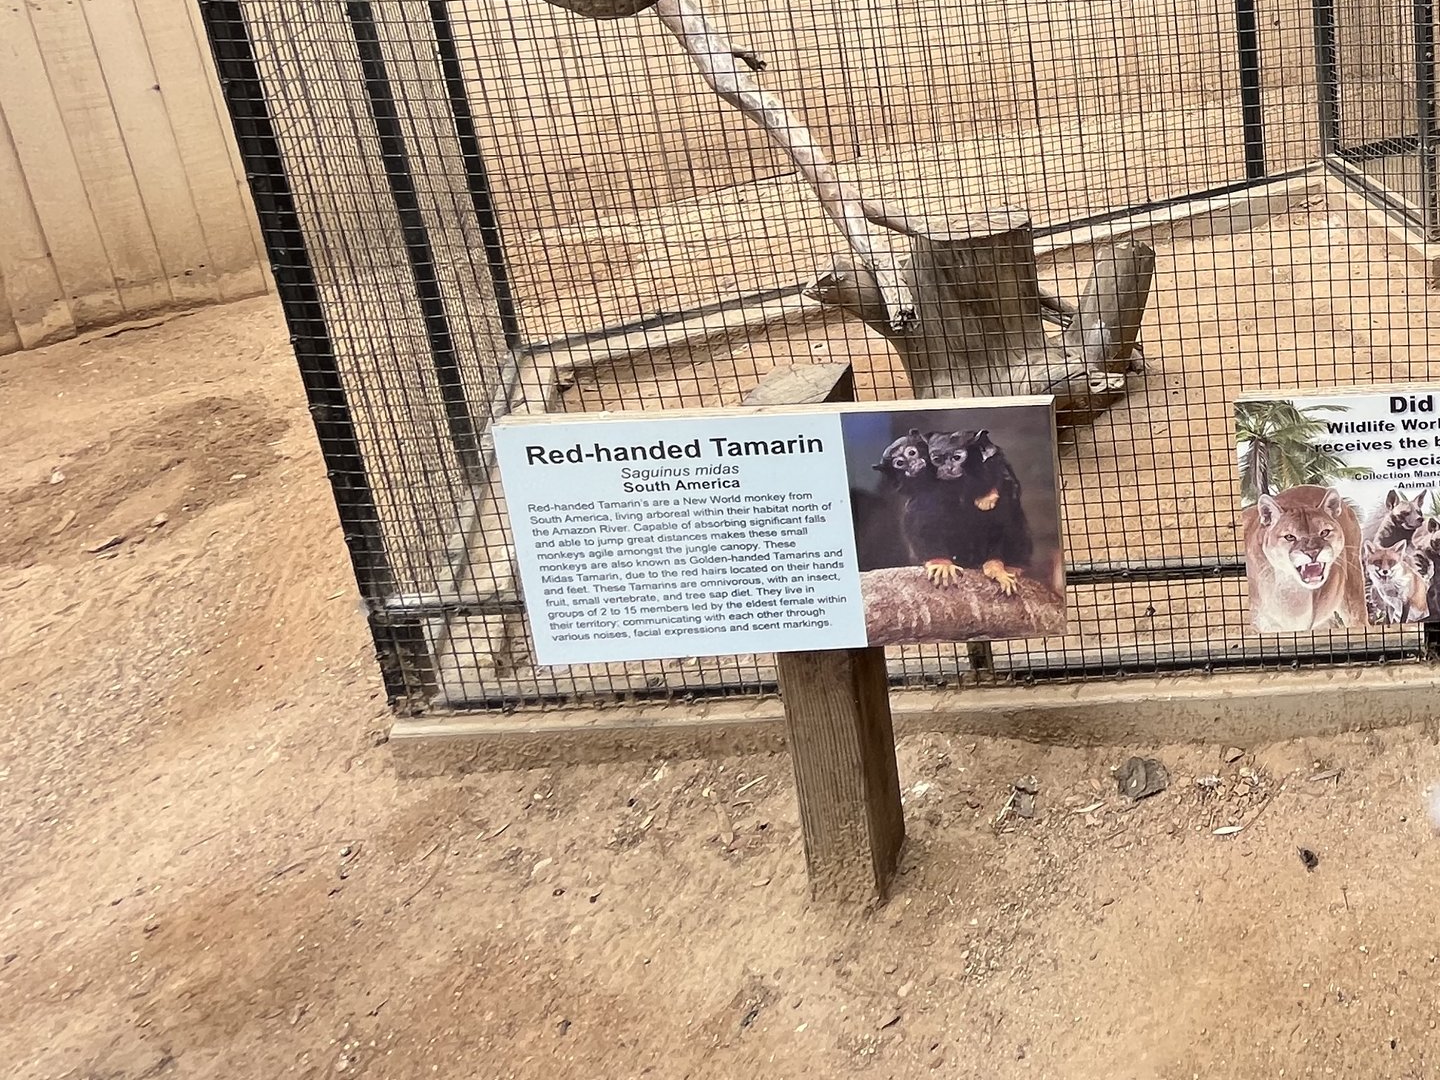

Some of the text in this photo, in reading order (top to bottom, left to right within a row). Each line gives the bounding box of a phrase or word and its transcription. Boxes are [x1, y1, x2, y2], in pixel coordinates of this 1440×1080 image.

[1389, 394, 1433, 414] Did
[1326, 419, 1395, 434] Wildlife
[525, 434, 823, 465] Red-handed Tamarin
[1314, 438, 1392, 453] receives
[1399, 436, 1427, 448] the
[620, 463, 739, 480] Saguinus midas
[623, 477, 740, 492] South America
[527, 501, 594, 512] Red-handed
[682, 496, 707, 505] New
[709, 494, 741, 504] World
[743, 493, 786, 502] monkey
[788, 491, 812, 500] from
[529, 515, 562, 524] South
[614, 511, 643, 521] living
[646, 508, 690, 519] arboreal
[692, 507, 724, 516] within
[726, 505, 750, 515] their
[752, 504, 789, 514] habitat
[791, 503, 818, 512] north
[821, 501, 832, 510] of
[531, 527, 549, 536] the
[551, 526, 596, 535] Amazon
[633, 521, 677, 532] Capable
[680, 520, 691, 529] of
[694, 518, 746, 528] absorbing
[748, 516, 802, 527] significant
[804, 514, 826, 523] falls
[534, 539, 555, 548] and
[558, 538, 581, 547] able
[597, 536, 623, 547] jump
[626, 534, 654, 545] great
[656, 533, 707, 542] distances
[710, 530, 746, 539] makes
[748, 529, 777, 538] these
[780, 526, 808, 536] small
[536, 550, 585, 560] monkeys
[588, 548, 613, 559] agile
[616, 546, 663, 556] amongst
[665, 545, 682, 553] the
[685, 543, 717, 555] jungle
[762, 540, 796, 548] These
[539, 562, 587, 572] monkeys
[611, 559, 633, 568] also
[635, 558, 670, 566] known
[689, 552, 770, 564] Golden-handed
[772, 550, 820, 560] Tamarins
[823, 548, 842, 557] and
[541, 574, 574, 583] Midas
[624, 571, 645, 579] due
[647, 570, 658, 578] to
[660, 569, 678, 577] the
[681, 567, 698, 576] red
[700, 566, 727, 575] hairs
[729, 564, 768, 574] located
[770, 564, 784, 572] on
[786, 562, 810, 571] their
[812, 560, 844, 569] hands
[543, 586, 564, 595] and
[592, 583, 626, 592] These
[627, 582, 677, 591] Tamarins
[679, 580, 697, 588] are
[699, 577, 764, 587] omnivorous,
[766, 574, 788, 583] with
[806, 572, 840, 581] insect,
[572, 596, 600, 605] small
[602, 594, 659, 603] vertebrate,
[662, 591, 682, 600] and
[708, 590, 728, 599] sap
[755, 587, 782, 597] They
[784, 585, 802, 594] live
[804, 584, 814, 593] in
[547, 594, 846, 620] groups of 2 to 15 members led by the eldest female within
[549, 621, 573, 630] their
[622, 615, 701, 626] communicating
[703, 612, 725, 621] with
[728, 611, 754, 620] each
[756, 610, 783, 618] other
[785, 607, 825, 617] through
[551, 632, 590, 641] various
[593, 631, 631, 639] noises,
[633, 627, 661, 637] facial
[663, 625, 727, 636] expressions
[729, 622, 749, 631] and
[751, 621, 780, 630] scent
